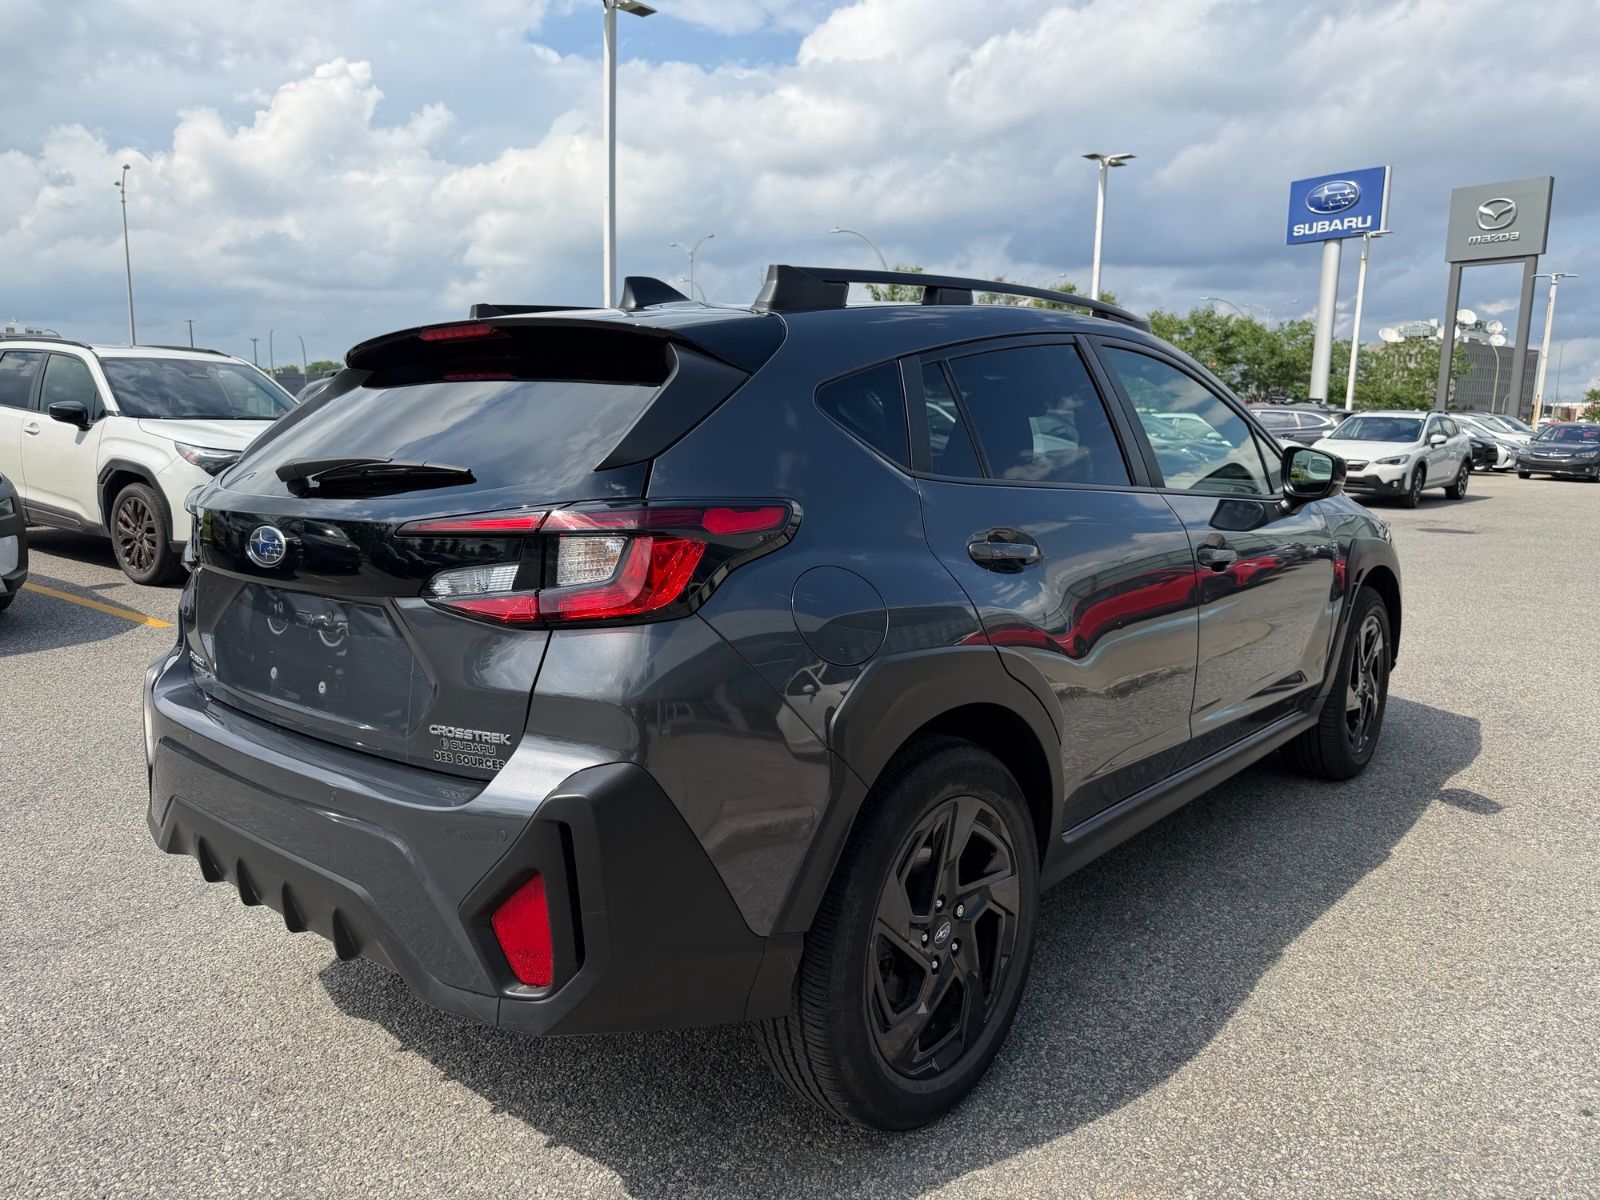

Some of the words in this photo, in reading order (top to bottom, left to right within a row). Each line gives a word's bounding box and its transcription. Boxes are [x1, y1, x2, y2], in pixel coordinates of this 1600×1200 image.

[1293, 215, 1372, 236] SUBARU
[1468, 231, 1520, 245] mazda
[429, 724, 511, 745] CROSSTREK
[450, 739, 496, 755] SUBARU
[433, 749, 453, 763] DES
[456, 754, 505, 770] SOURCES
